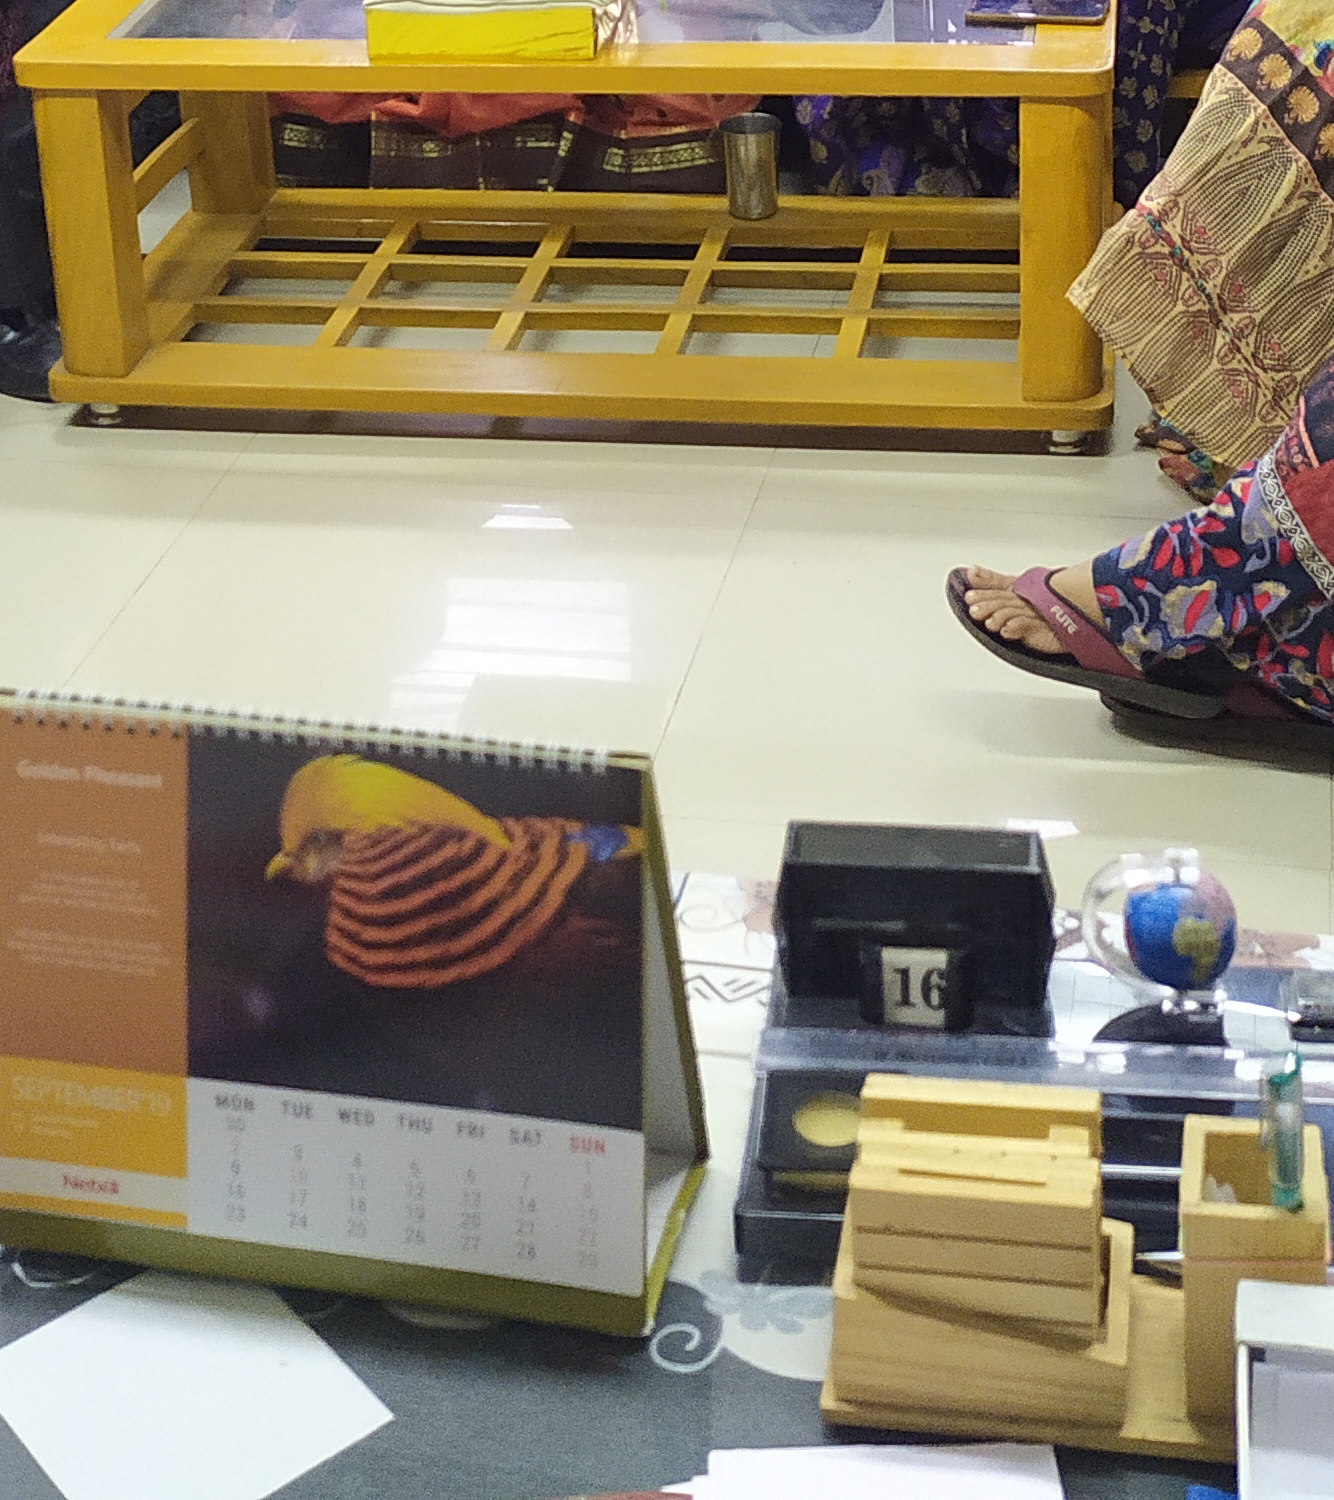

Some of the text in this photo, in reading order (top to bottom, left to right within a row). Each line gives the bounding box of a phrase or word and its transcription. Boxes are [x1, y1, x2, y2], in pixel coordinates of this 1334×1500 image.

[892, 967, 947, 1012] 16
[215, 1094, 606, 1154] MON TUE WED THU FRI SAT SUN
